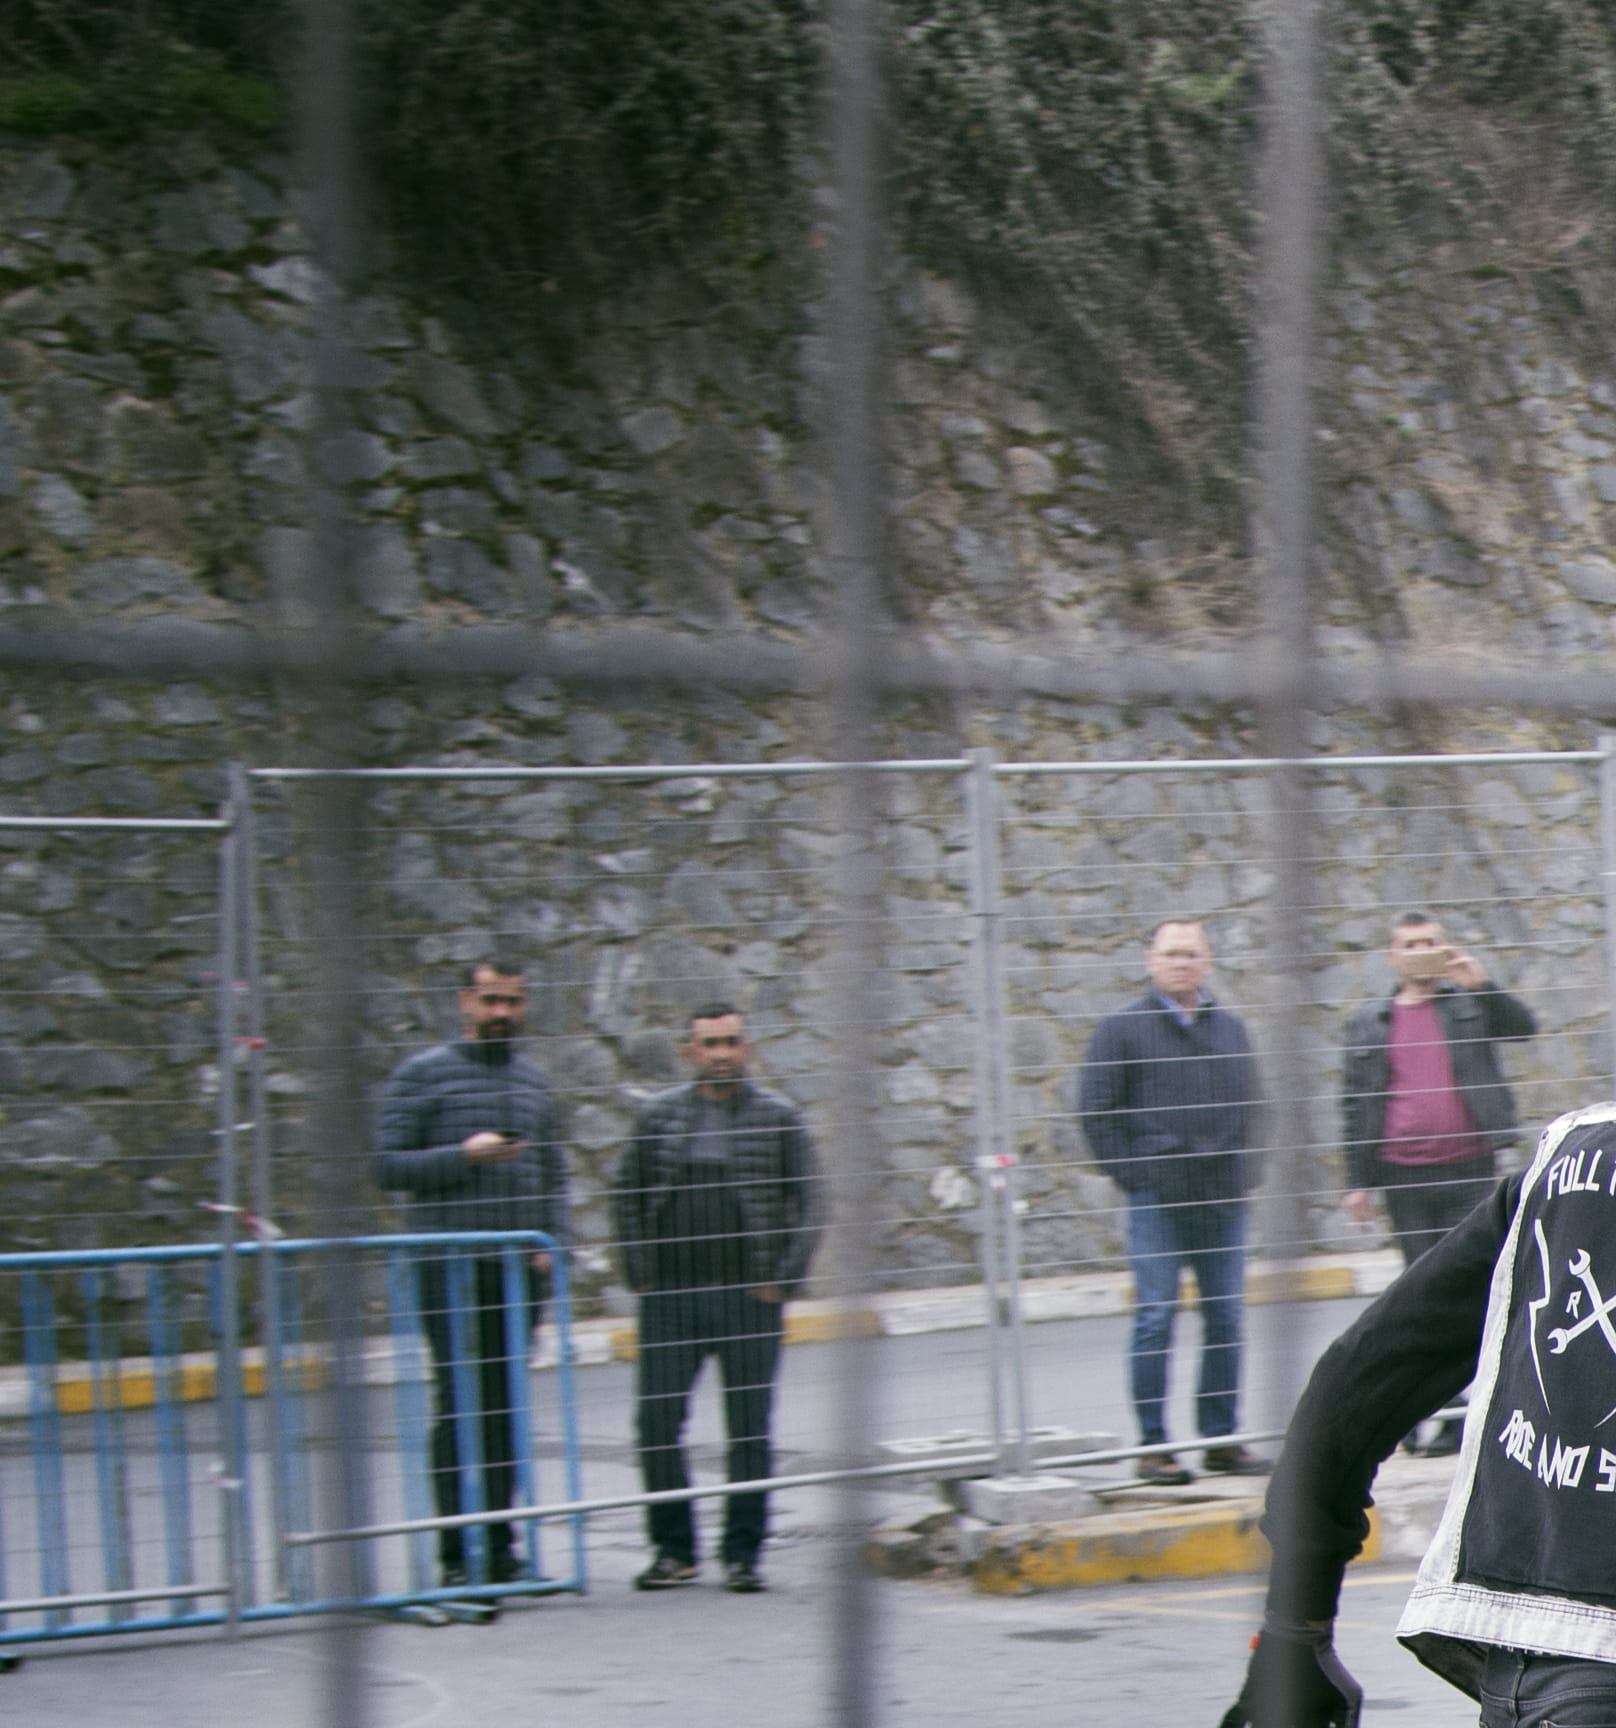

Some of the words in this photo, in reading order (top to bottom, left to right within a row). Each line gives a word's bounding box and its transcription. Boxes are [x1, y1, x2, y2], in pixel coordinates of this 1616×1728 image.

[1547, 1149, 1603, 1200] FULL
[1565, 1290, 1582, 1320] R
[1498, 1409, 1536, 1472] RIDE
[1537, 1432, 1591, 1490] AND
